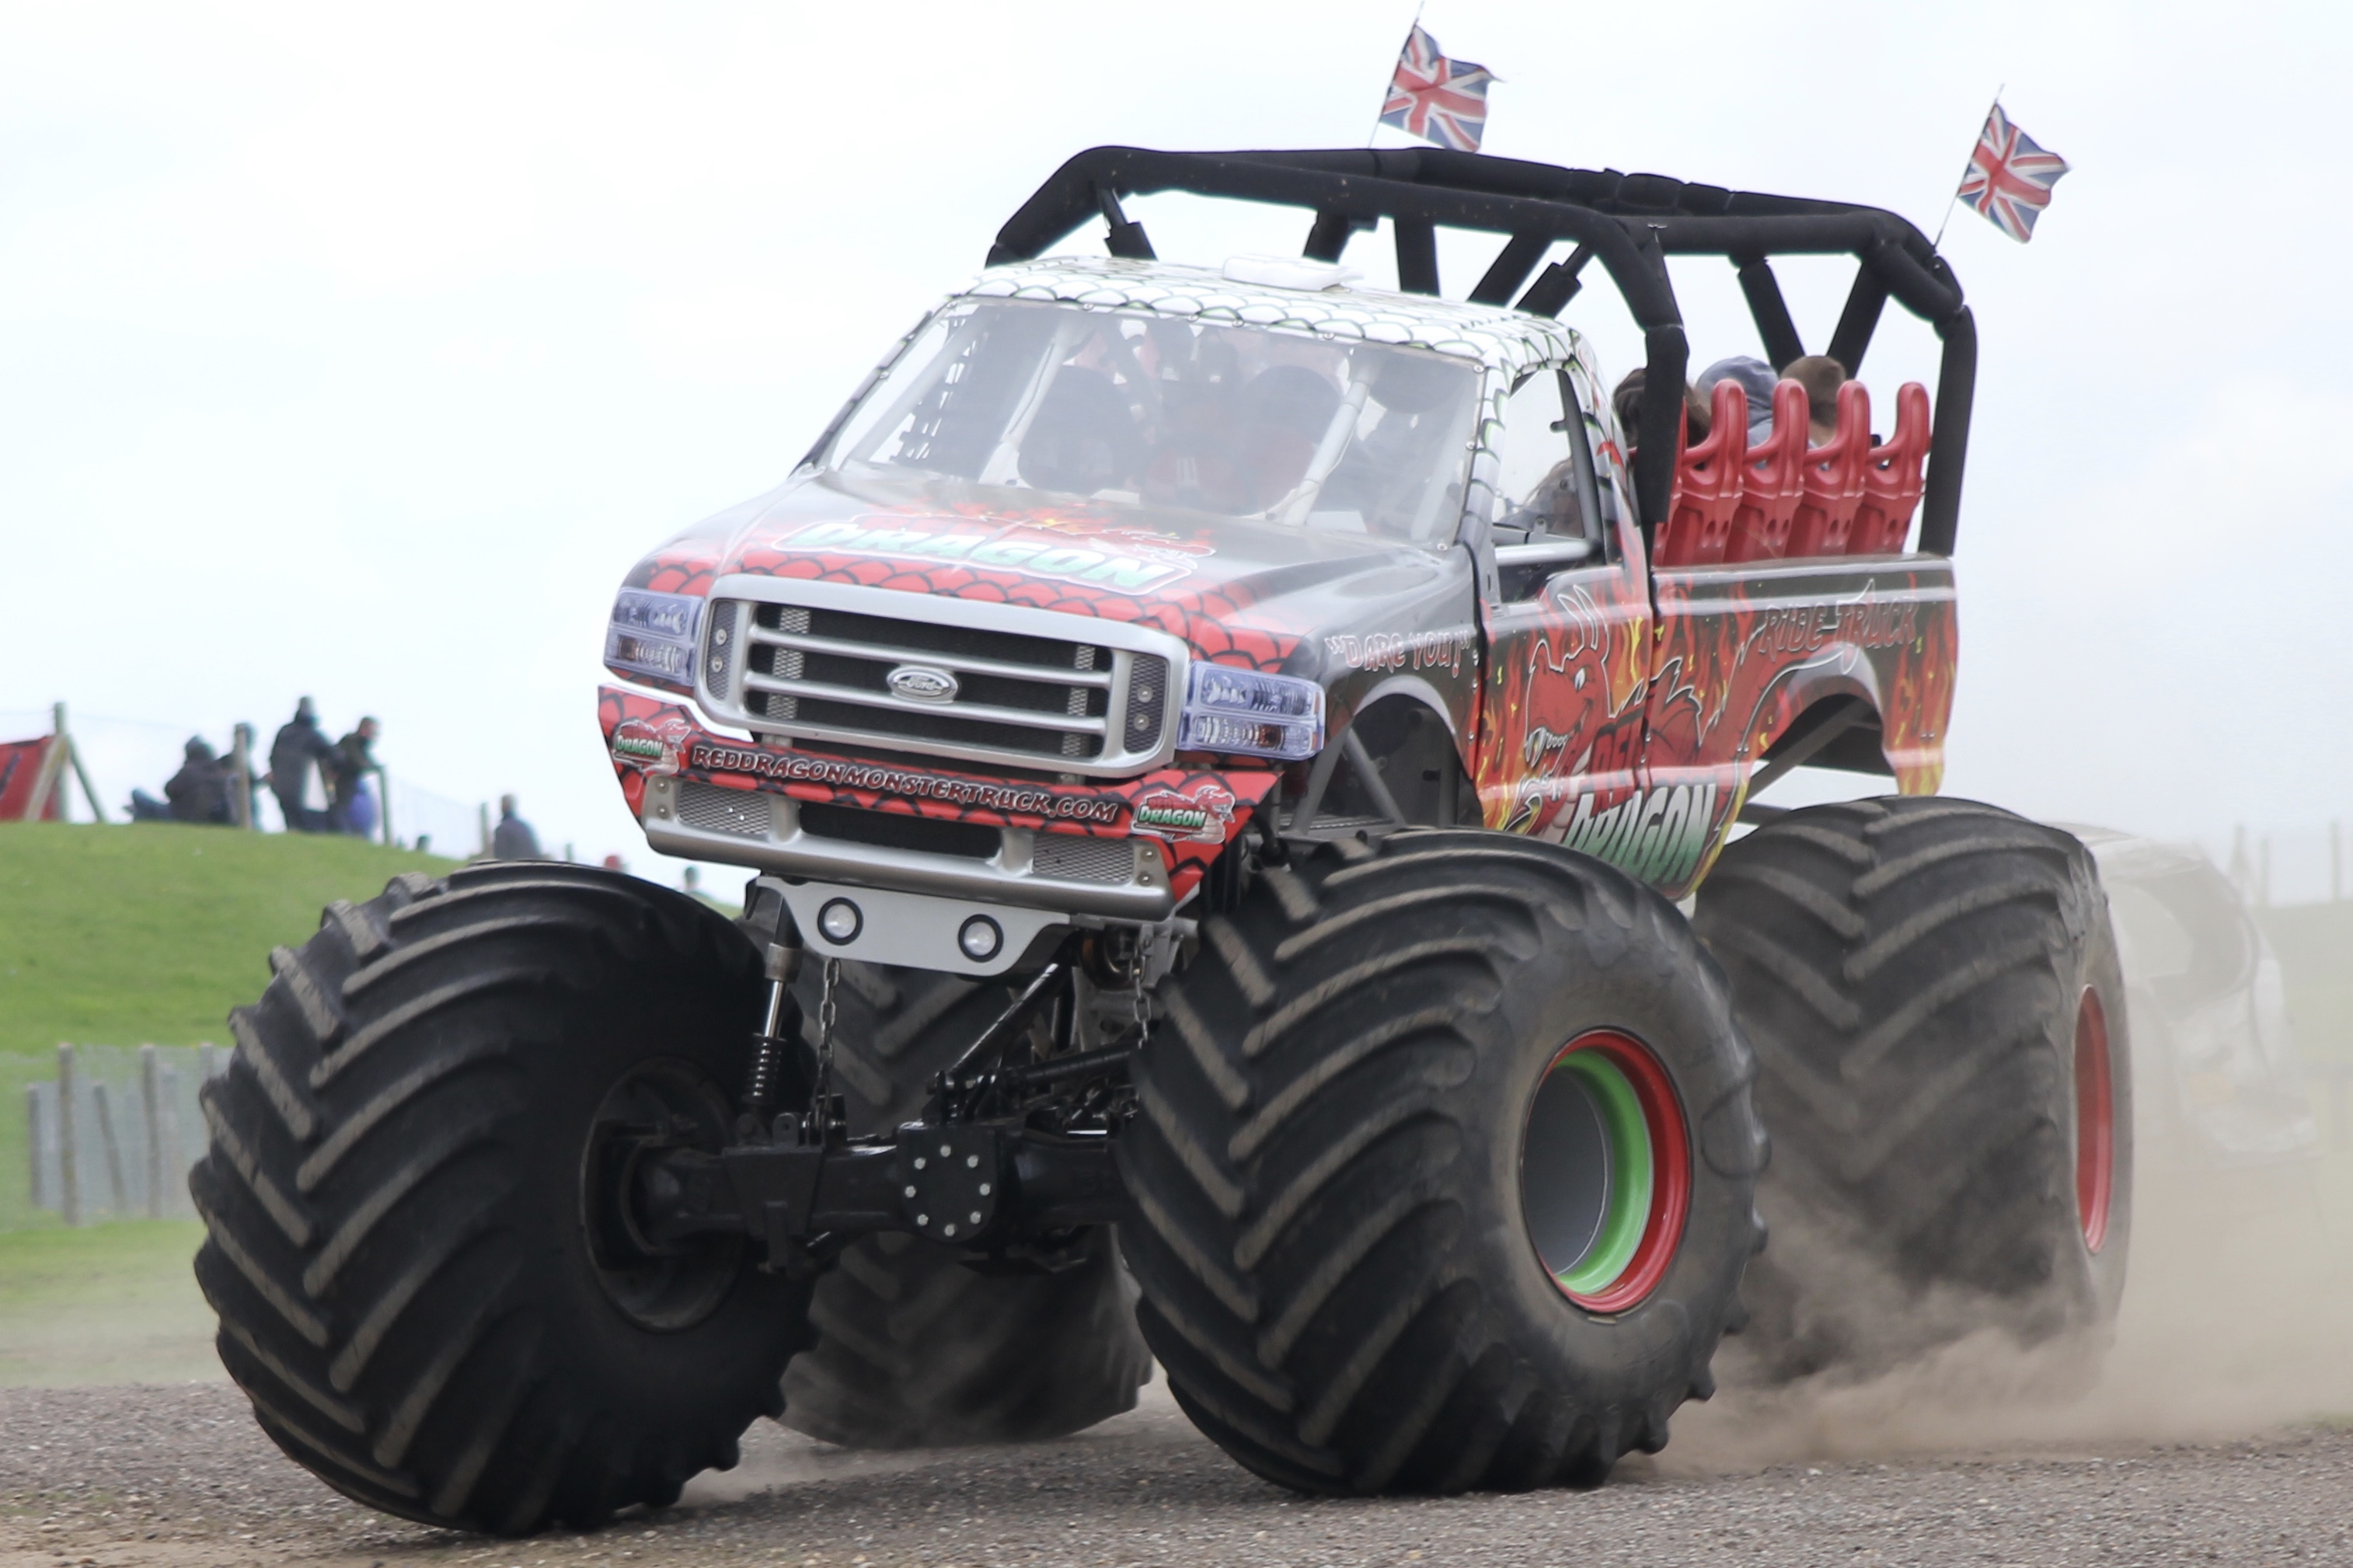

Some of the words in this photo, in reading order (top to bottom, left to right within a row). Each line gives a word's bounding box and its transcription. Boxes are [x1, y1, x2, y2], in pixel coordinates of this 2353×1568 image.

[793, 523, 1176, 588] DRAGON
[1835, 595, 1919, 653] TRUCK
[616, 735, 663, 758] DRAGON
[692, 747, 1118, 823] REDDRAGONMONSTERTRUCK.COM
[1138, 806, 1207, 827] DRAGON
